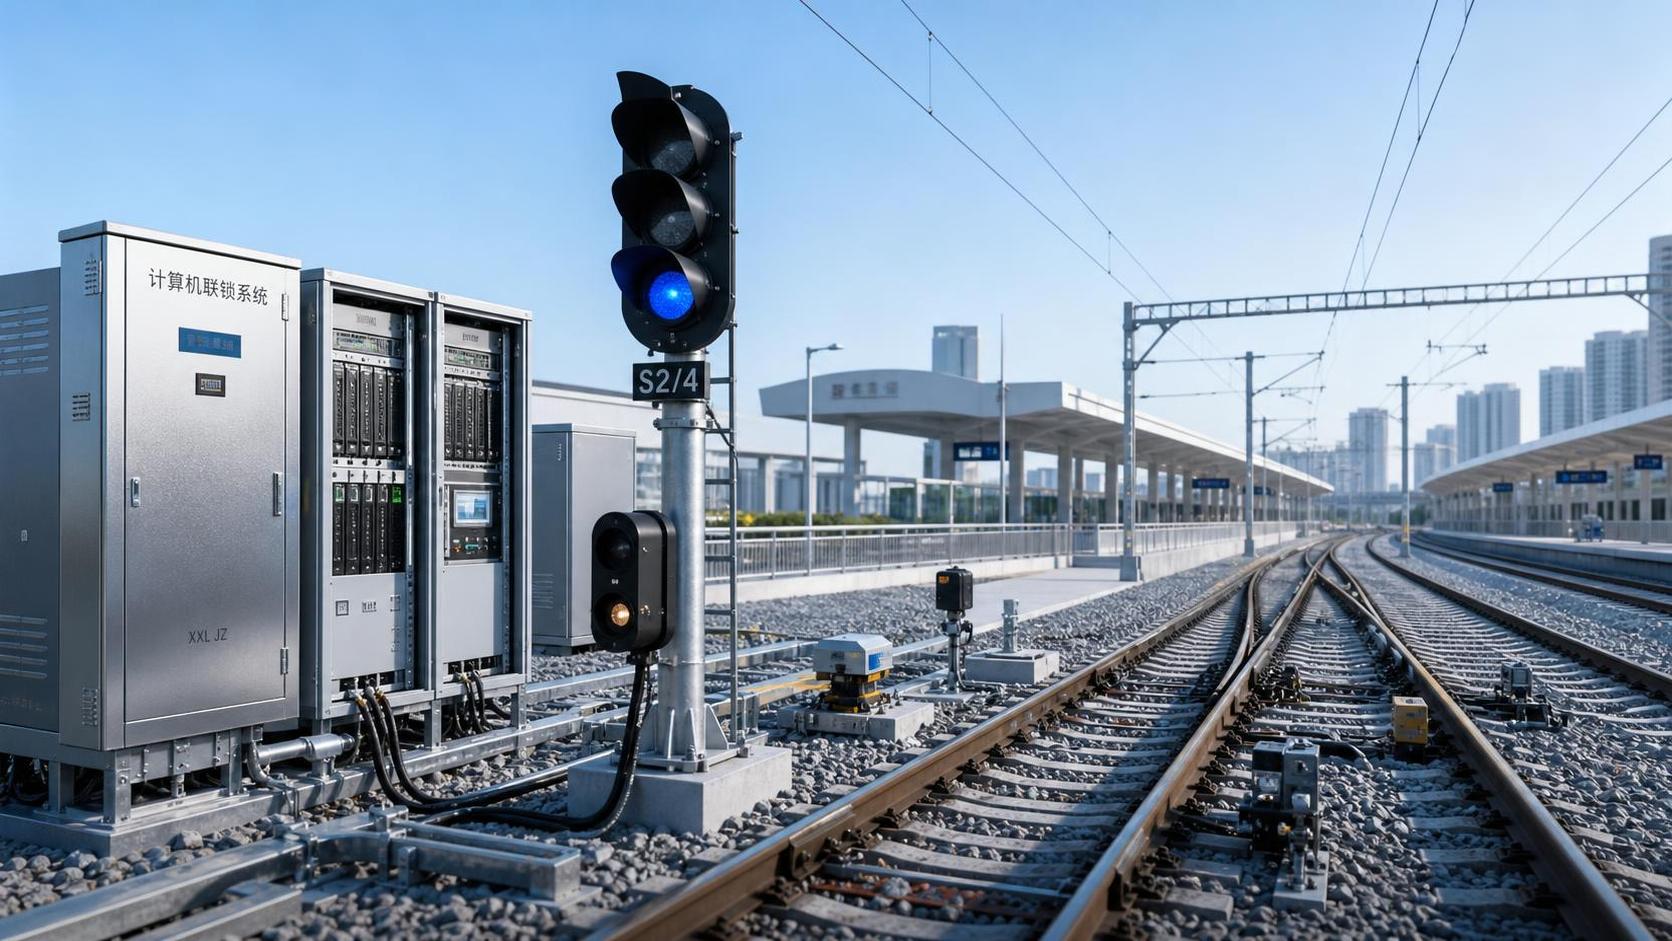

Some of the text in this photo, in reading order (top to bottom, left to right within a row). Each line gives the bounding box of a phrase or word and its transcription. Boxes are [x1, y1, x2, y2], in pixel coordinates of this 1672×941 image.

[149, 268, 268, 306] 计算机联锁系统
[639, 368, 698, 394] S2/4
[188, 627, 228, 645] XXL JZ
